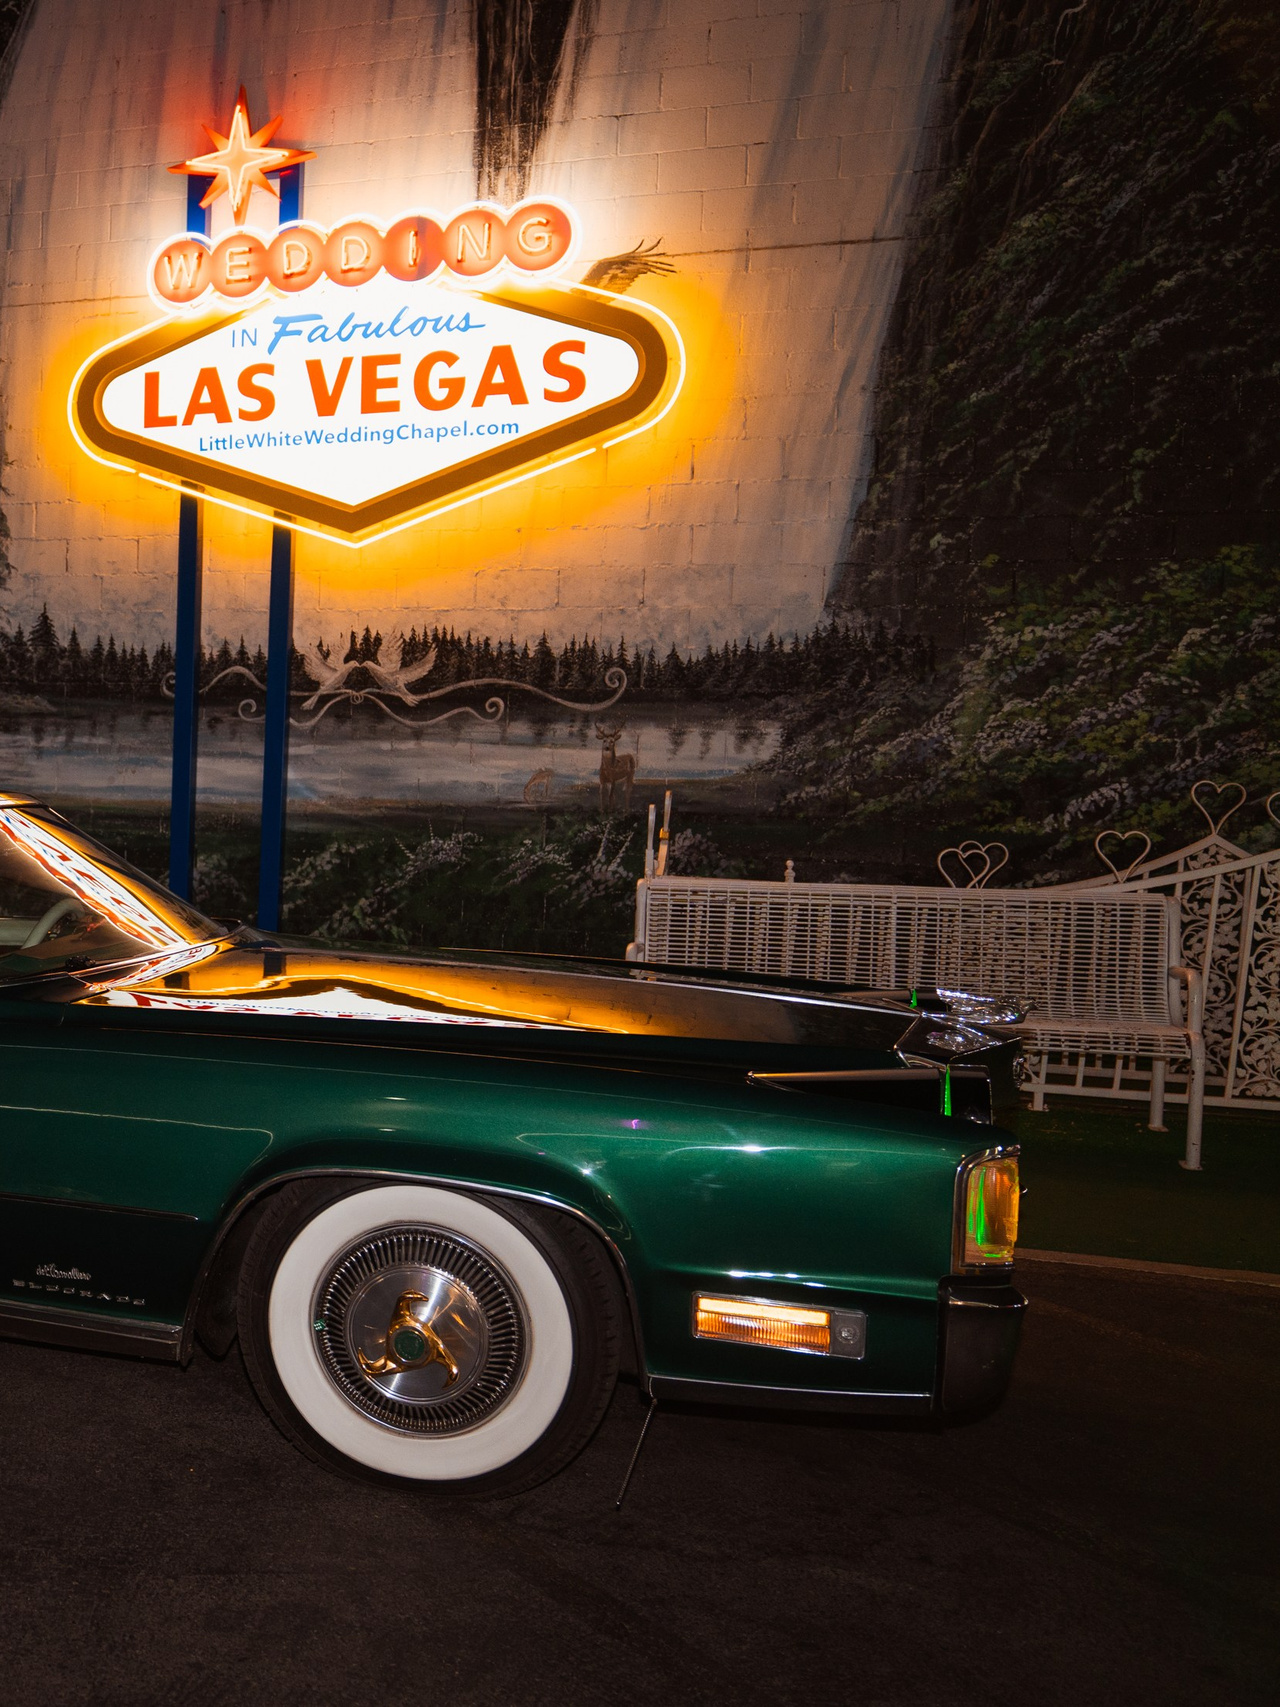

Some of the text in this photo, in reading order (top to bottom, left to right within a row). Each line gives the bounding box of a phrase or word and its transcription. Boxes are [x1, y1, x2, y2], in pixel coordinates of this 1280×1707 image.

[163, 215, 552, 290] WEDDING
[231, 305, 486, 355] IN Fabulous
[143, 339, 587, 429] LAS VEGAS
[199, 420, 520, 452] LittleWhiteWeddingChapel.com
[12, 1278, 146, 1306] ELDORADO
